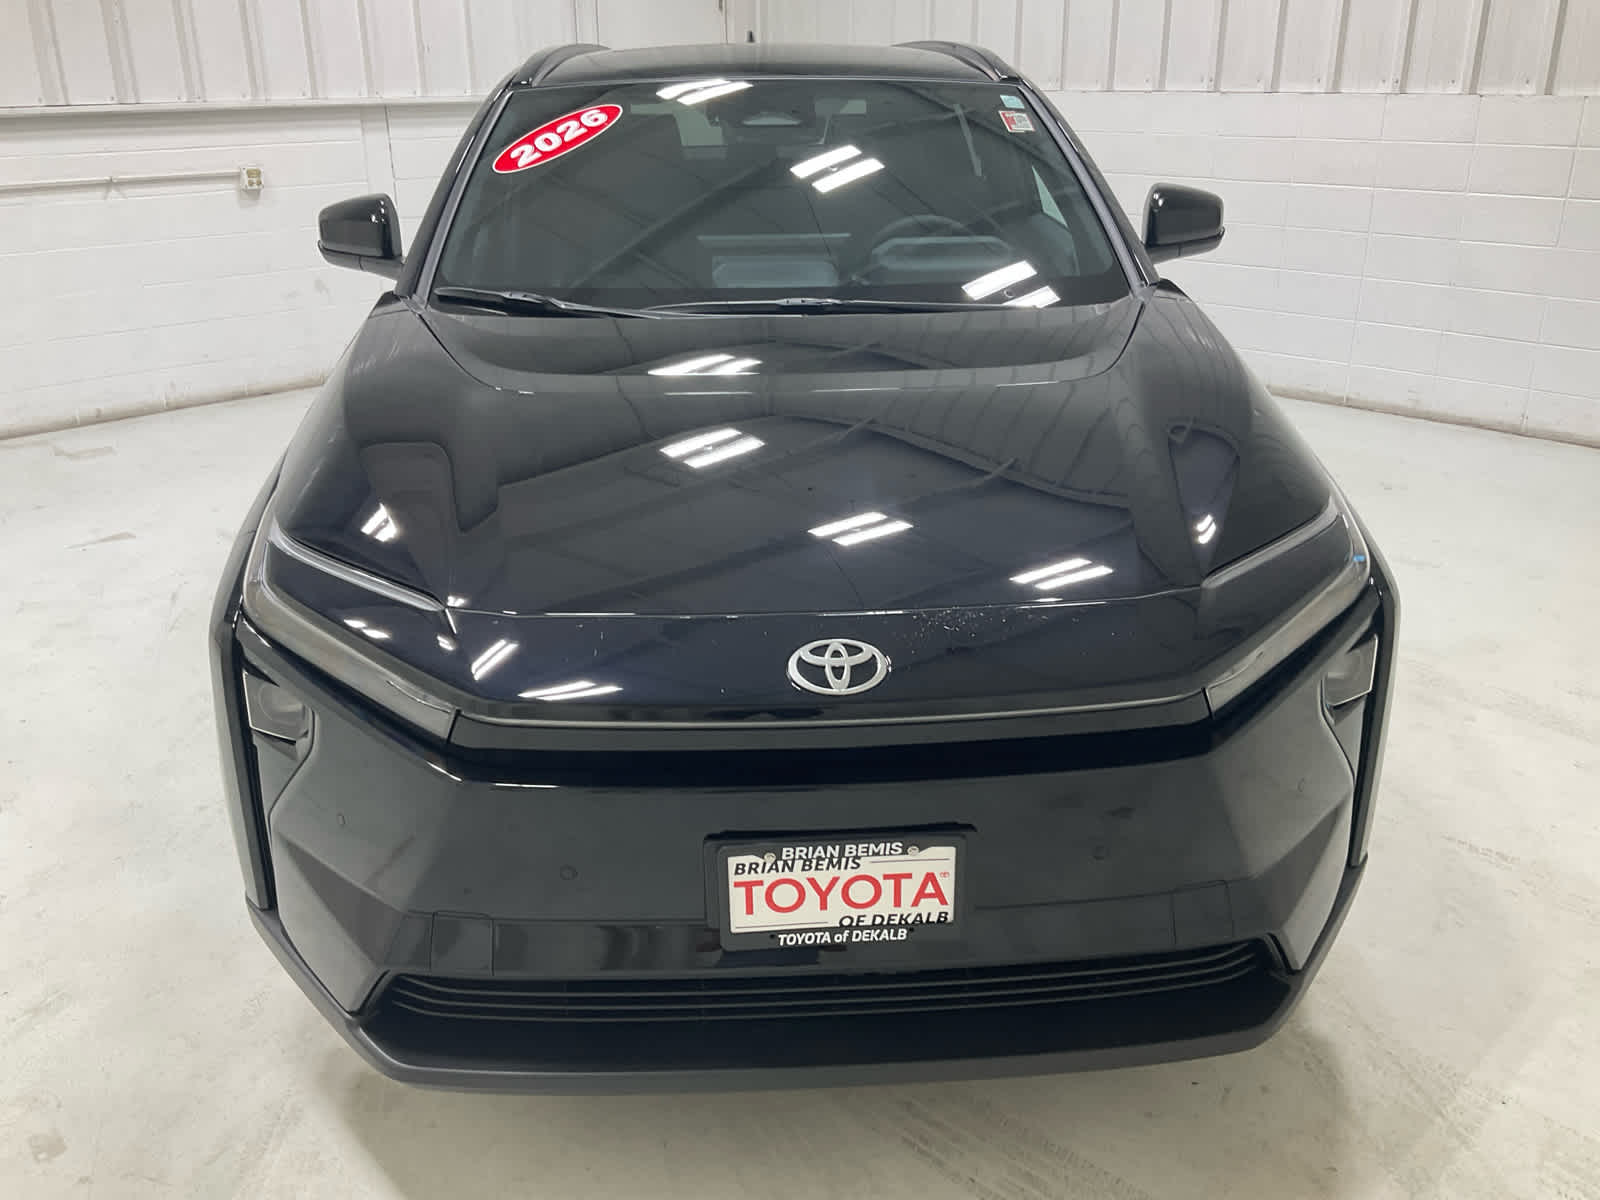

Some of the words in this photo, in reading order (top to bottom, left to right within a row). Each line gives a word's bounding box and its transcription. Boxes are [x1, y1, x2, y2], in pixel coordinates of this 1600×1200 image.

[510, 109, 608, 168] 2026
[781, 845, 839, 860] BRIAN
[844, 842, 903, 857] BEMIS
[734, 859, 795, 875] BRIAN
[801, 856, 861, 872] BEMIS
[734, 872, 949, 915] TOYOTA
[839, 915, 866, 927] OF
[872, 911, 949, 926] DEKALB
[778, 932, 831, 946] TOYOTA
[834, 932, 849, 943] of
[852, 928, 907, 942] DEKALB
